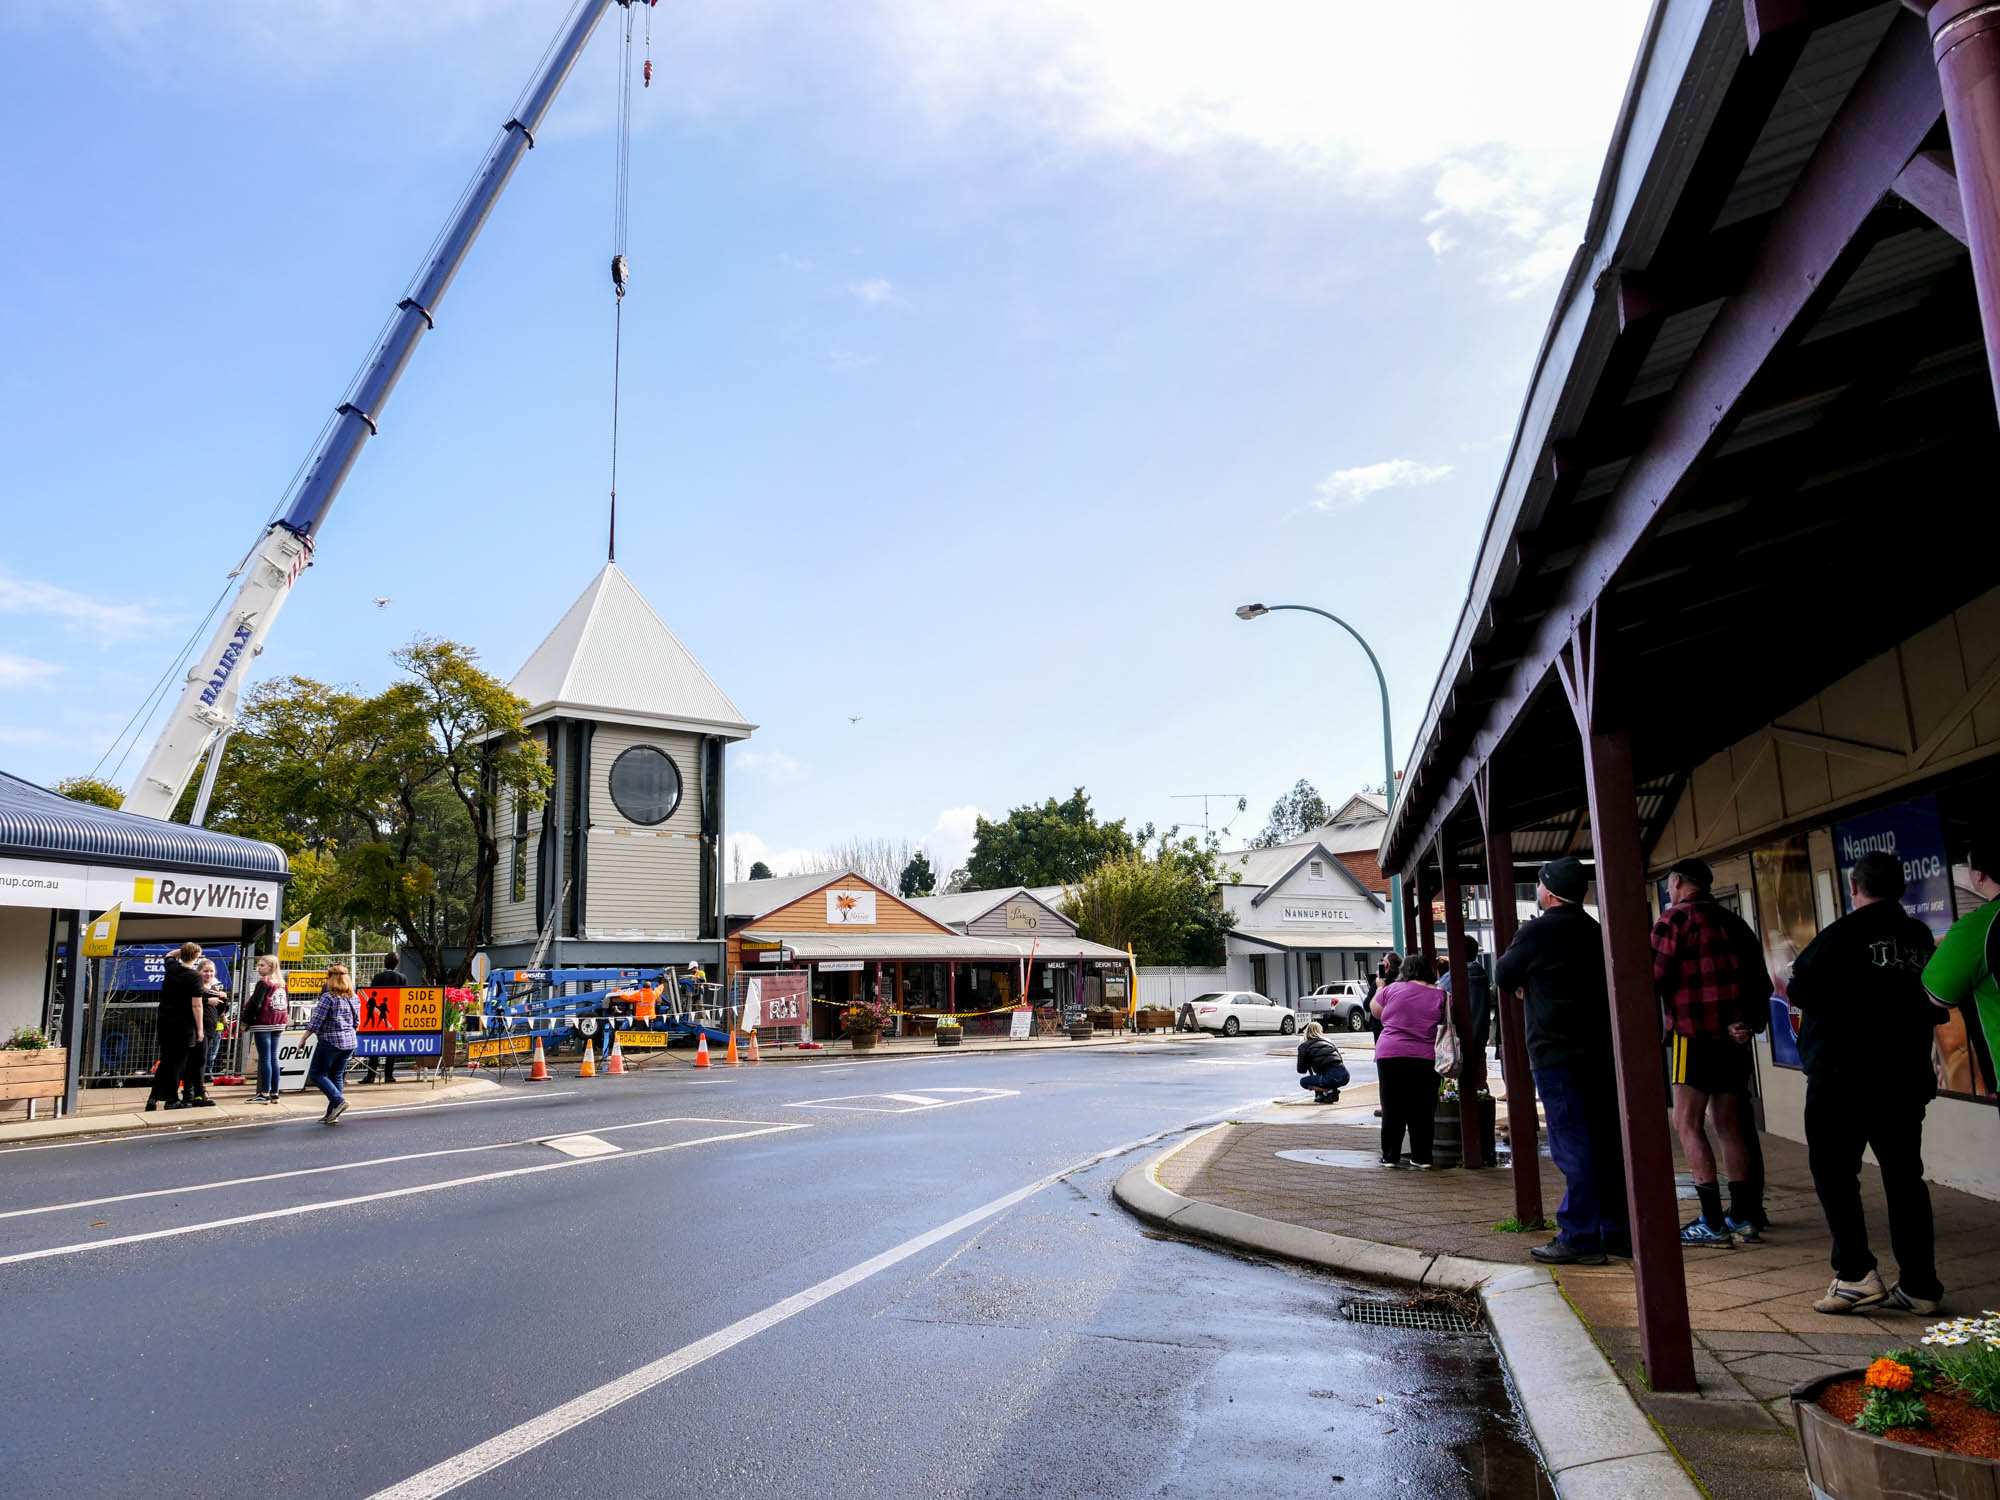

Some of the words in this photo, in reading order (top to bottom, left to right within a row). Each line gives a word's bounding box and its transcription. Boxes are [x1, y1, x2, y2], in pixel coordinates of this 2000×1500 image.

[200, 624, 251, 706] HALIFAX
[1843, 830, 1896, 861] Nannup
[1285, 908, 1320, 918] NANNUP
[1321, 909, 1349, 919] HOTEL
[408, 990, 434, 1001] SIDE
[404, 1004, 436, 1014] ROAD
[403, 1017, 437, 1028] CLOSED
[620, 1034, 637, 1043] ROAD
[639, 1035, 663, 1043] CLOSED
[363, 1039, 406, 1053] THANK
[409, 1038, 434, 1052] YOU
[279, 1045, 313, 1060] OPEN
